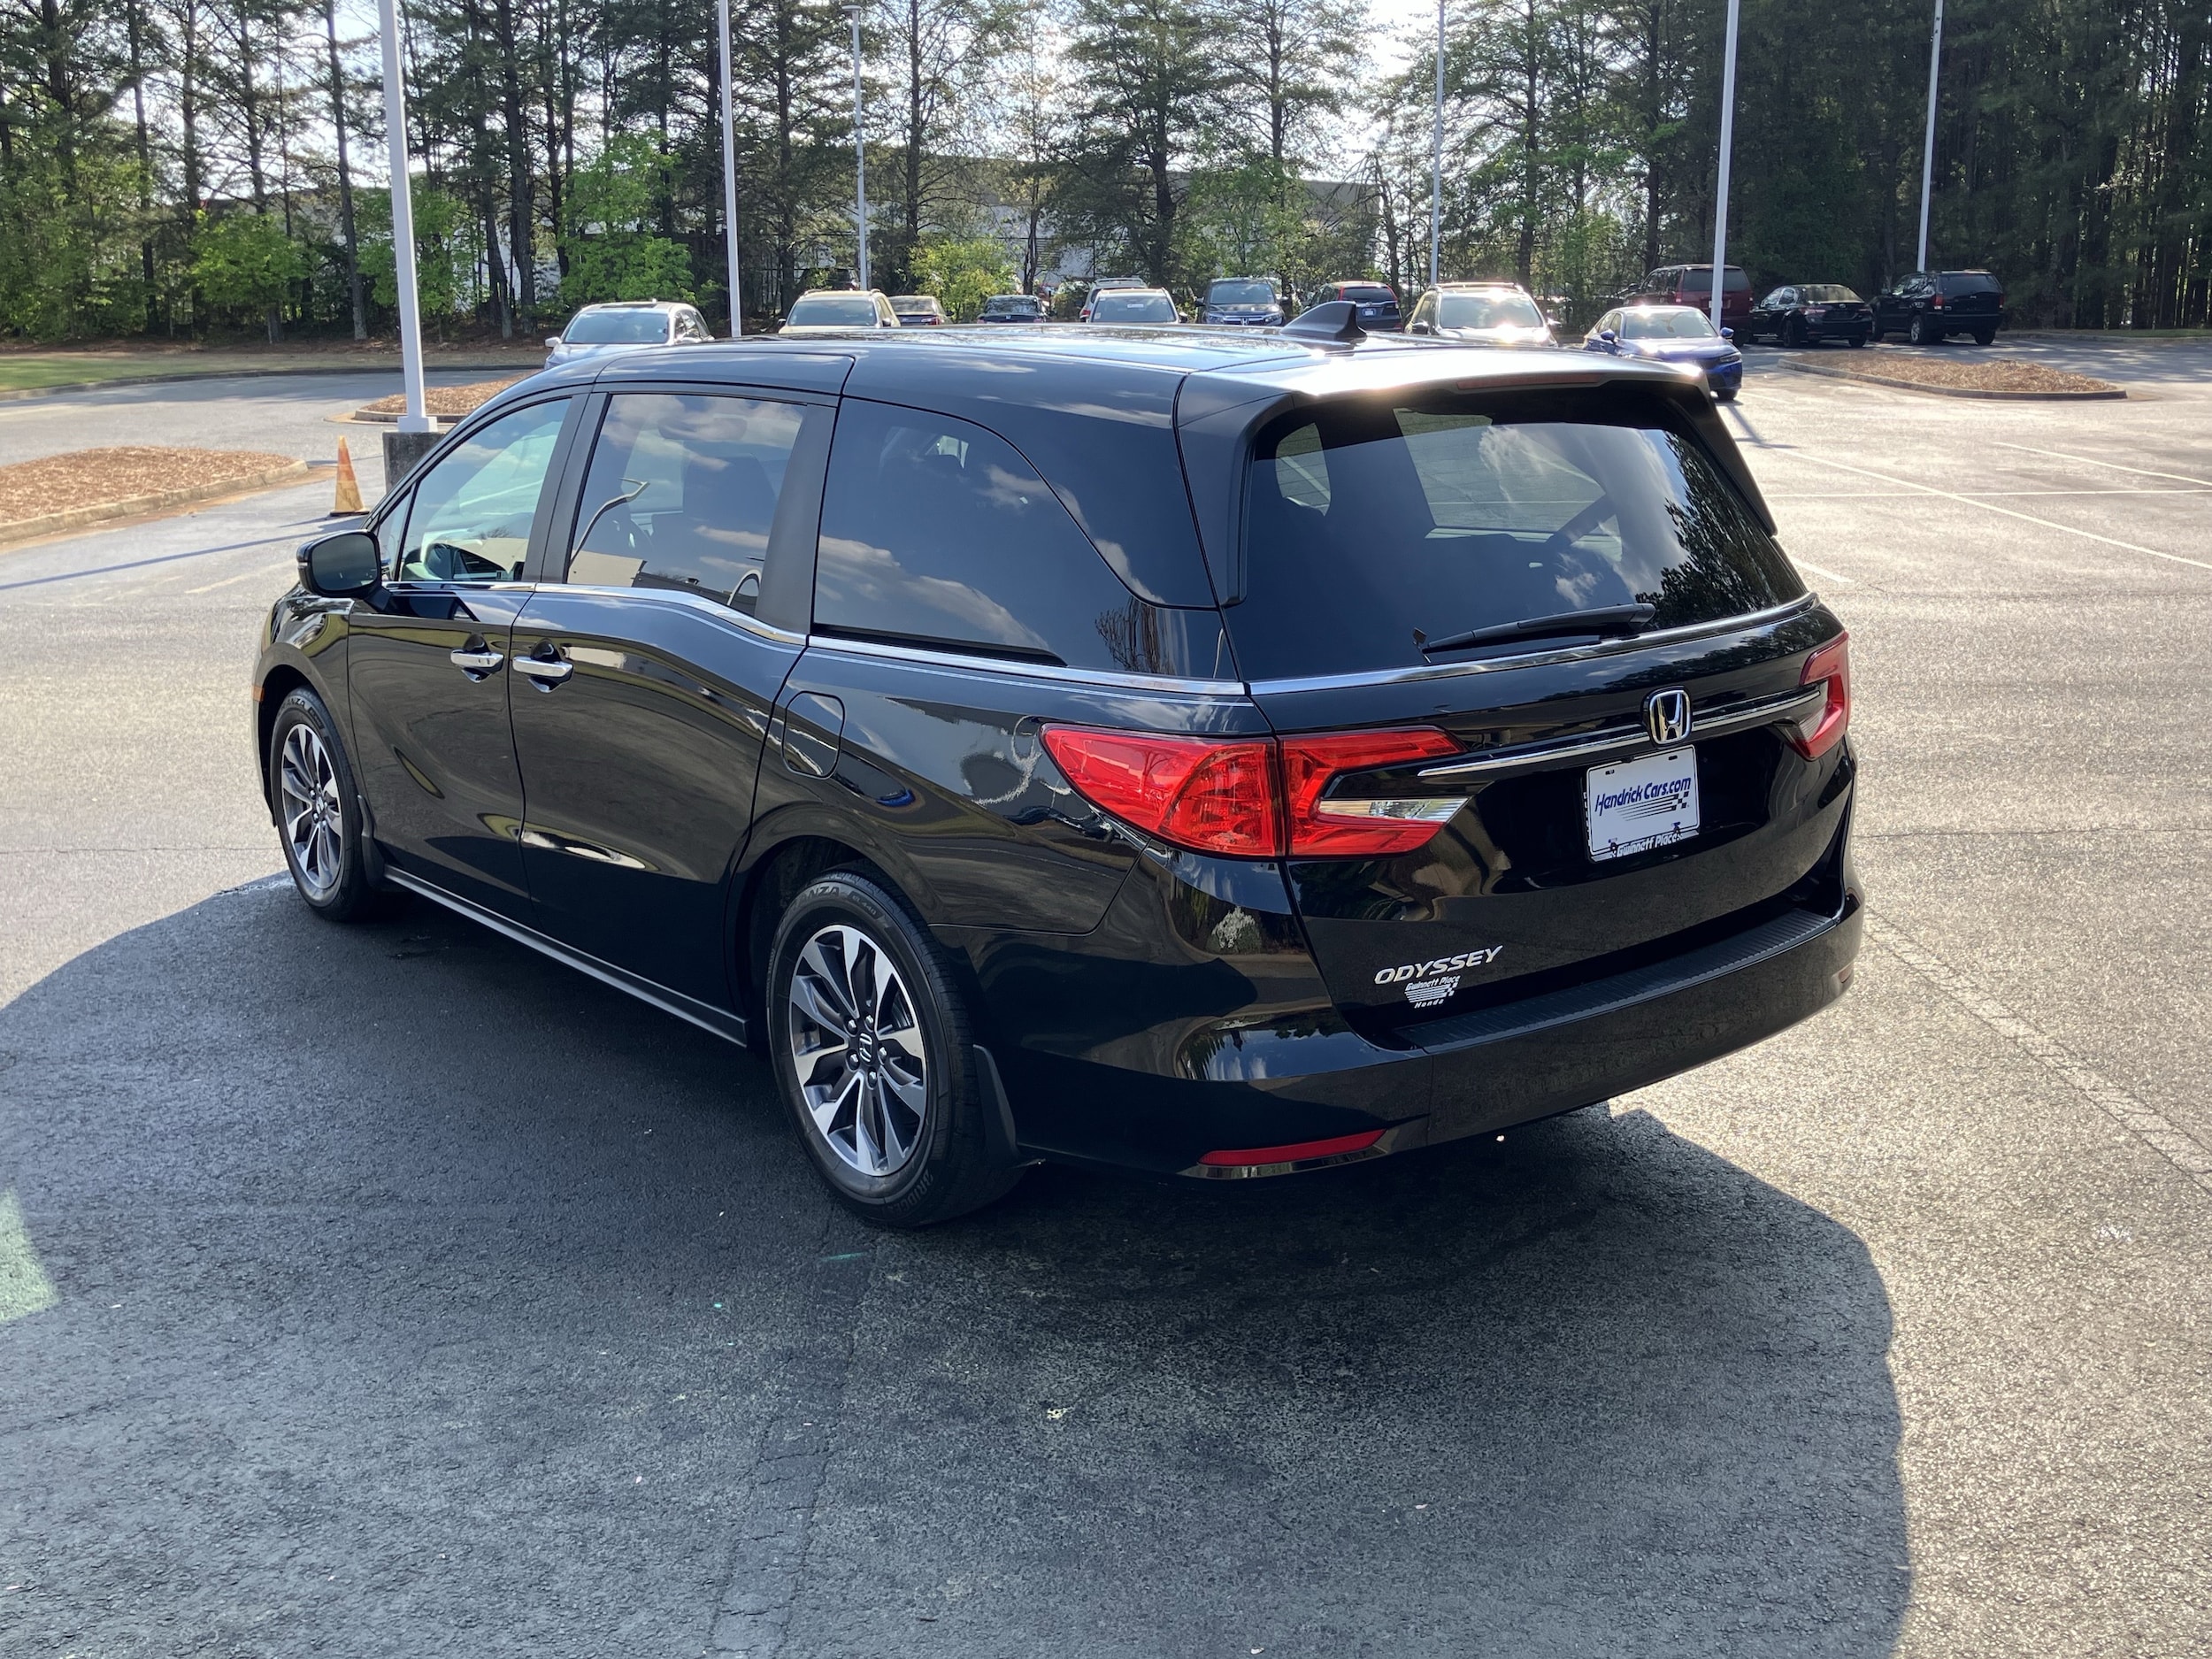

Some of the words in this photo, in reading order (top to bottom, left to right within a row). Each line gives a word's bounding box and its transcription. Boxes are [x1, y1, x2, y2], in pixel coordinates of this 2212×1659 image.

[1374, 944, 1503, 985] ODYSSEY
[1405, 977, 1439, 992] Gwinnett
[1439, 975, 1461, 987] Place
[1414, 998, 1445, 1009] Honda
